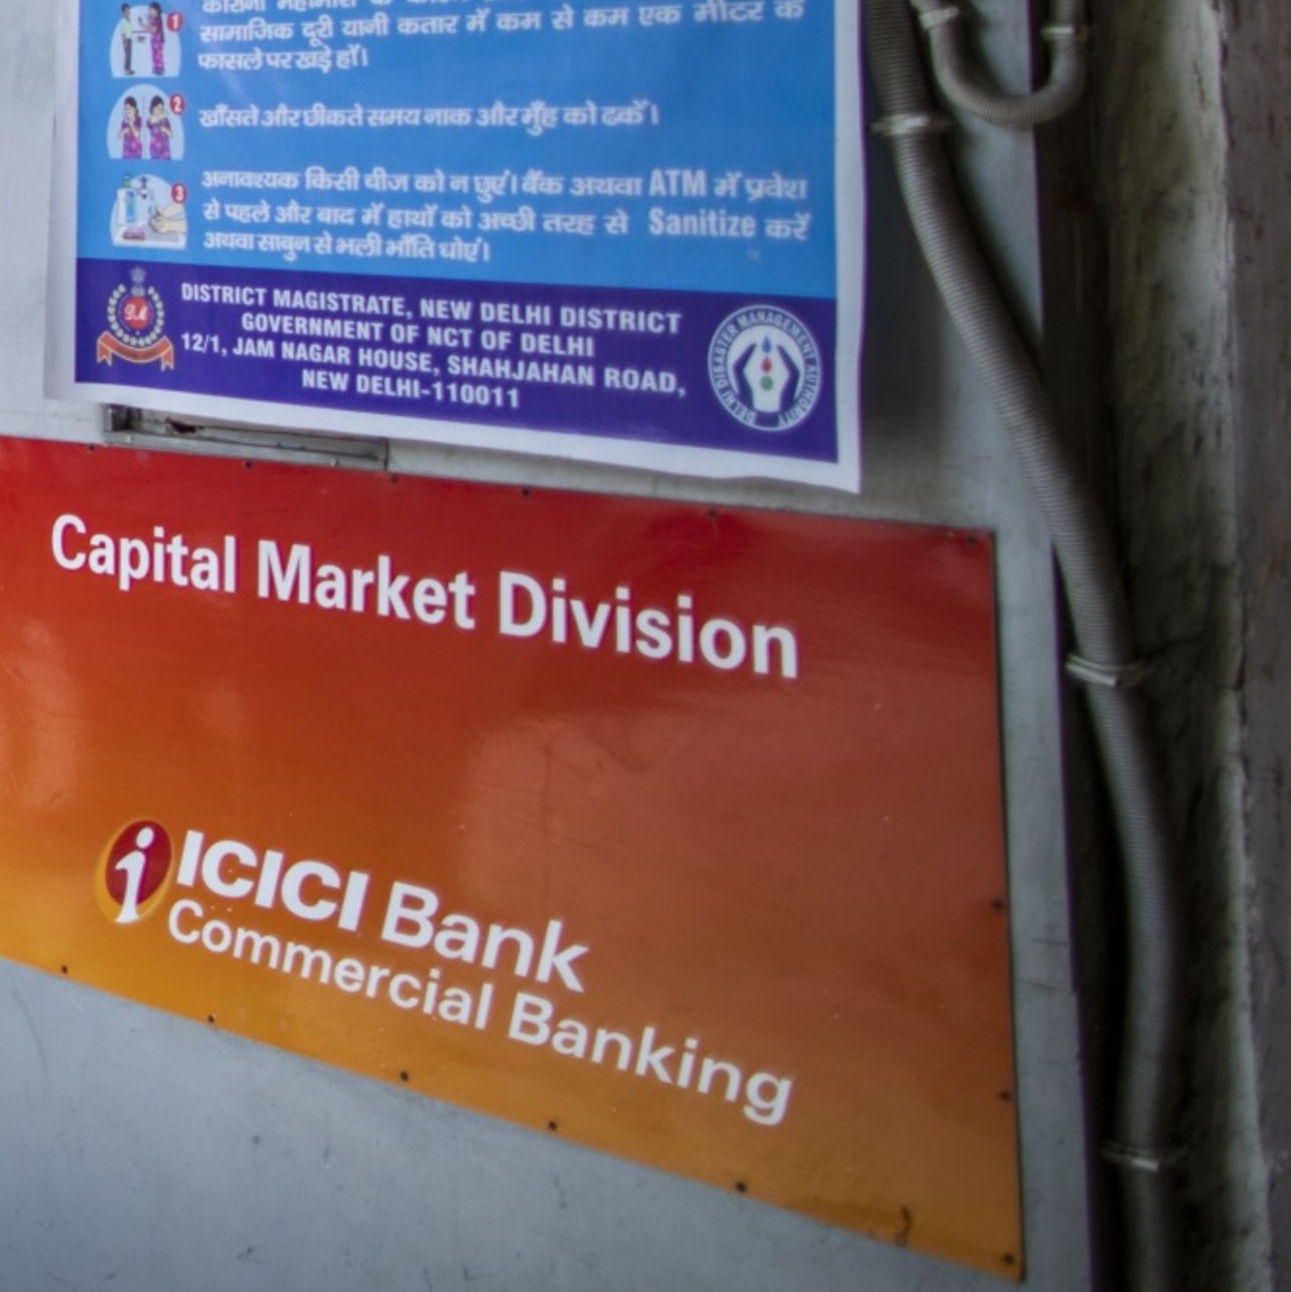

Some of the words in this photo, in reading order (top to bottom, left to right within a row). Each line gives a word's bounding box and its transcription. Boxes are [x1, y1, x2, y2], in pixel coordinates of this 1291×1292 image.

[200, 18, 293, 42] सामाजिक
[301, 14, 333, 47] दूरी
[342, 12, 388, 37] यानी
[397, 15, 459, 35] कतार
[466, 7, 490, 32] में
[496, 11, 541, 31] कम
[551, 3, 573, 30] से
[583, 7, 629, 28] कम
[638, 5, 683, 26] एक
[267, 50, 293, 69] पर
[261, 102, 299, 126] और
[367, 107, 421, 127] समय
[423, 107, 473, 126] नाक
[476, 100, 519, 126] और
[563, 99, 597, 126] को
[305, 165, 359, 192] किसी
[364, 166, 409, 192] चीज
[415, 169, 445, 193] को
[449, 173, 467, 194] न
[571, 174, 642, 197] अथवा
[648, 169, 707, 197] ATM
[715, 171, 743, 198] में
[745, 172, 809, 202] प्रवेश
[203, 198, 222, 221] से
[225, 199, 271, 224] पहले
[274, 199, 313, 225] और
[317, 205, 355, 226] बाद
[361, 202, 384, 226] में
[440, 201, 472, 230] को
[478, 205, 535, 232] अच्छी
[542, 212, 597, 236] तरह
[604, 208, 628, 234] से
[648, 206, 757, 238] Sanitize
[764, 212, 812, 241] करें
[203, 231, 254, 250] अथवा
[257, 232, 310, 262] साबुन
[314, 230, 333, 255] से
[335, 232, 382, 257] भली
[181, 282, 266, 307] DISTRICT
[273, 288, 413, 319] MAGISTRATE,
[420, 298, 472, 321] NEW
[480, 301, 551, 326] DELHI
[560, 306, 682, 334] DISTRICT
[242, 312, 384, 342] GOVERNMENT
[390, 324, 420, 344] OF
[427, 327, 473, 348] NCT
[481, 330, 512, 351] OF
[521, 332, 595, 357] DELHI
[713, 323, 739, 390] DISASTER
[736, 310, 816, 359] MANAGEMENT
[181, 333, 228, 357] 12/1,
[232, 338, 275, 358] JAM
[281, 341, 351, 366] NAGAR
[358, 348, 441, 376] HOUSE,
[447, 354, 595, 386] SHAHJAHAN
[604, 367, 687, 398] ROAD,
[302, 369, 350, 391] NEW
[356, 374, 519, 408] DELHI-110011
[50, 514, 236, 593] Capital
[257, 538, 475, 630] Market
[499, 570, 799, 678] Division
[177, 829, 368, 931] ICICI
[382, 881, 590, 993] Bank
[168, 899, 491, 1031] Commercial
[508, 999, 794, 1127] Banking
